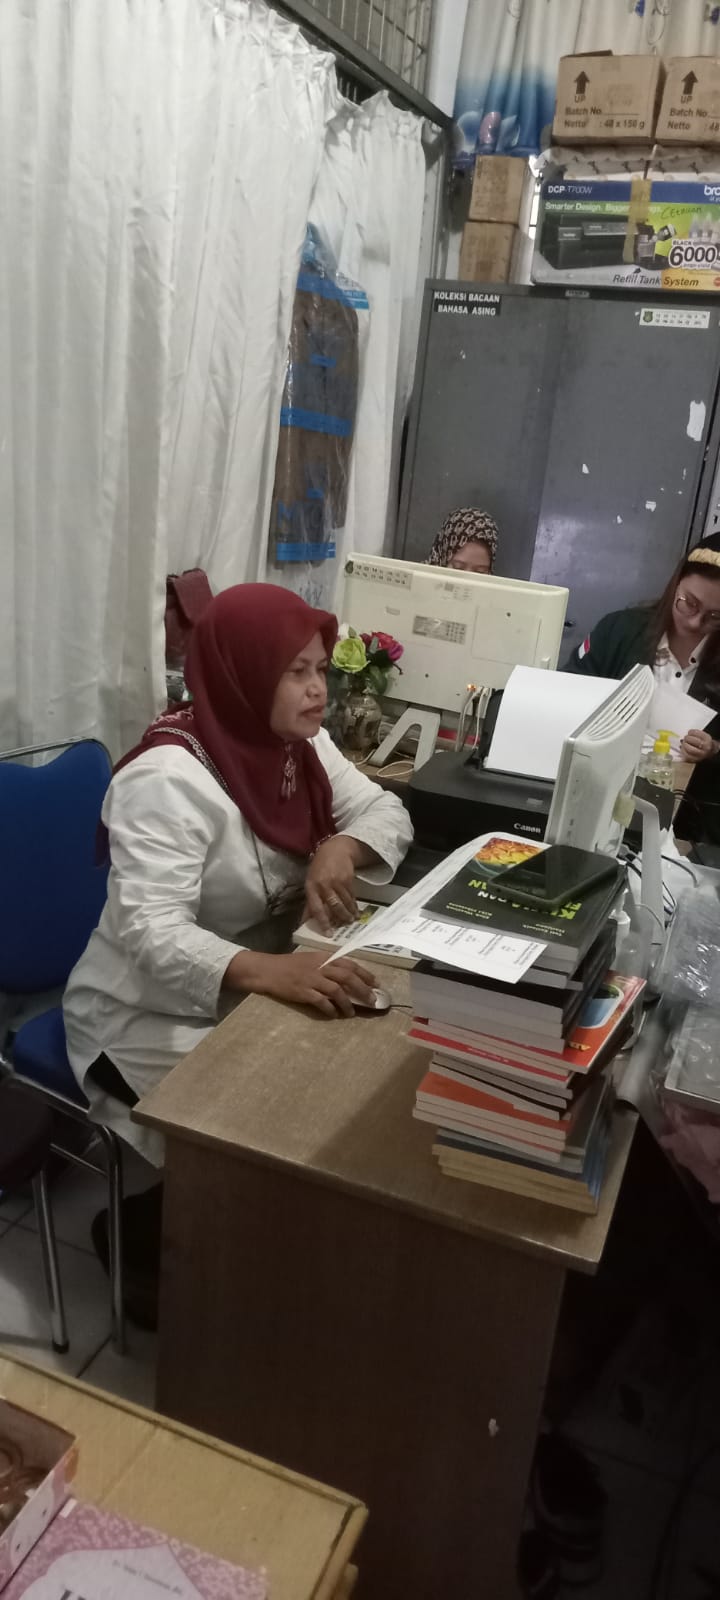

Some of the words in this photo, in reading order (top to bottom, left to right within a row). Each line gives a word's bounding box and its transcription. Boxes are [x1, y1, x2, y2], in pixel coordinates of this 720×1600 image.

[574, 95, 586, 104] UP
[680, 95, 692, 104] UP
[564, 107, 588, 116] Batch
[670, 107, 693, 117] Batch
[564, 119, 586, 128] Netto
[639, 121, 646, 130] g
[667, 121, 691, 130] Netto
[547, 185, 593, 194] DCP-T700W
[545, 202, 574, 211] Smarter
[669, 245, 717, 267] 6000
[613, 274, 639, 285] Refill
[640, 275, 661, 286] Tank
[663, 277, 699, 288] System
[434, 291, 467, 301] KOLEKSI
[468, 293, 500, 303] BACAAN
[437, 304, 468, 314] BAHASA
[471, 306, 496, 316] ASING
[513, 822, 542, 834] Canon
